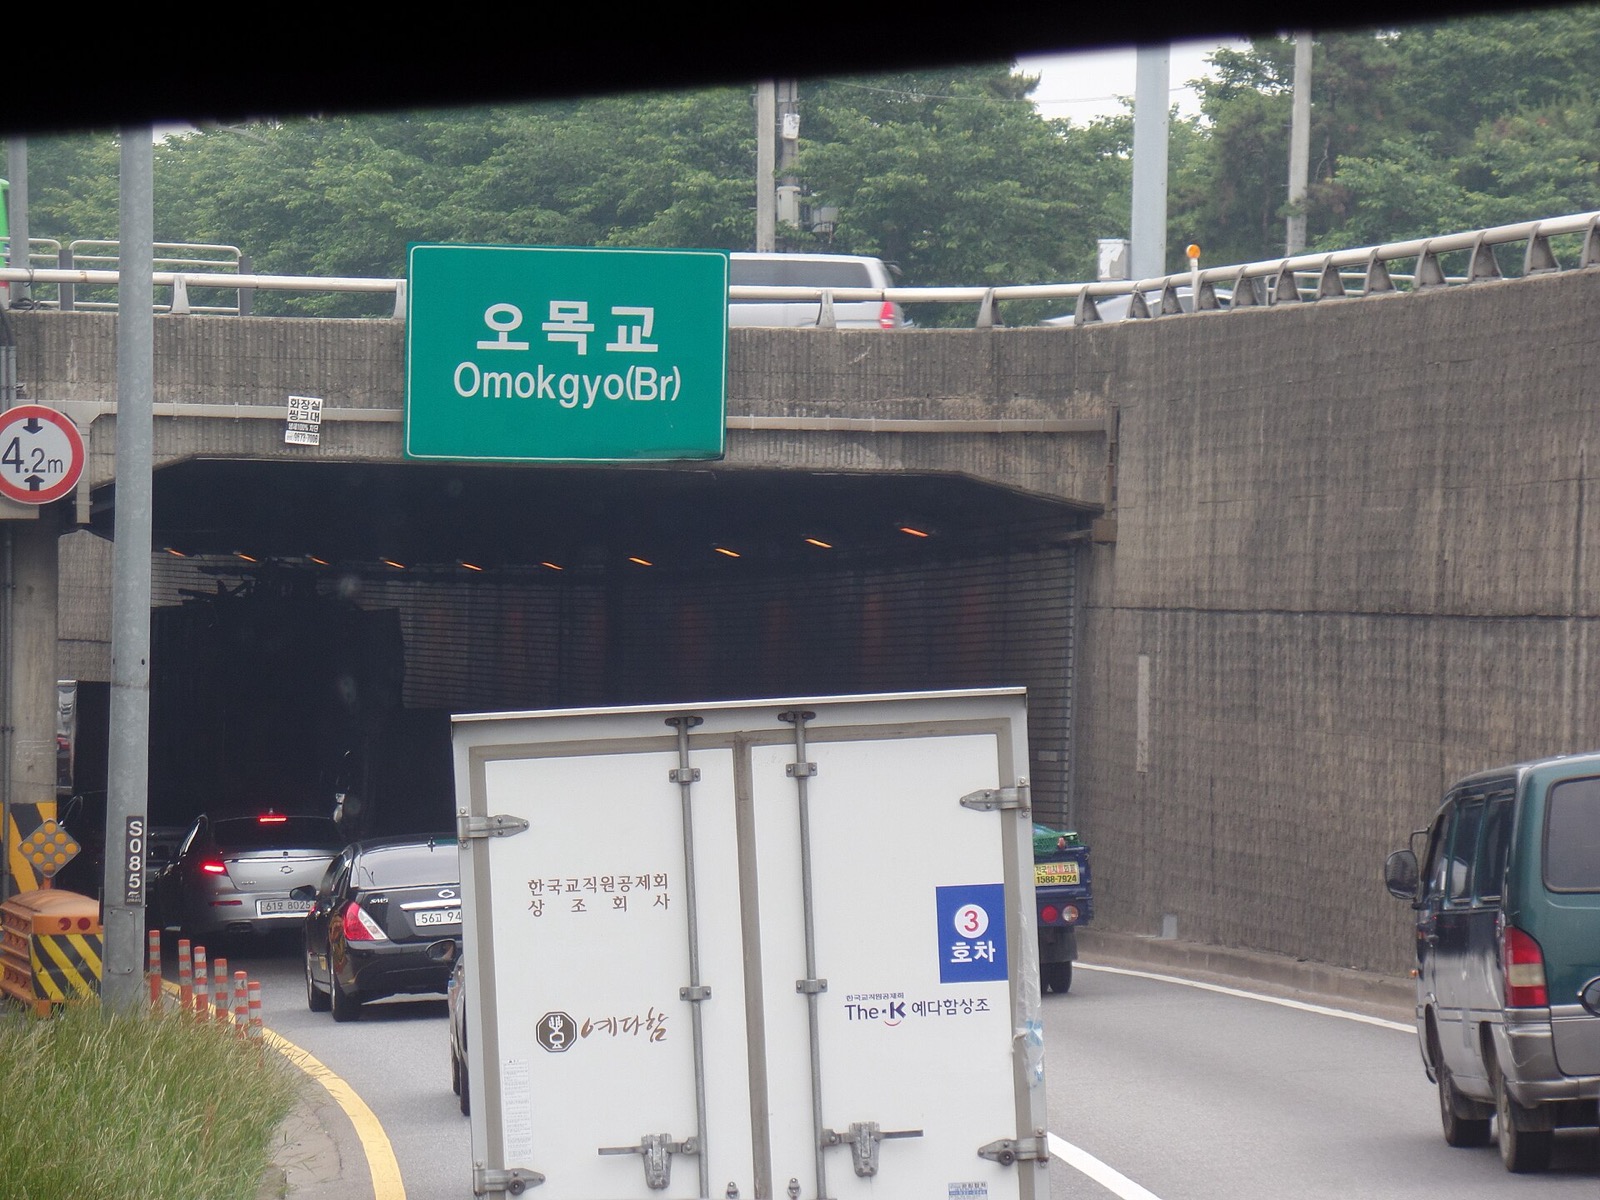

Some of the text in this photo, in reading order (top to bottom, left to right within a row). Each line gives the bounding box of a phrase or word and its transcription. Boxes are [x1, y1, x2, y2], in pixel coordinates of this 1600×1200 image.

[476, 300, 659, 355] 오목교
[453, 361, 681, 409] Omokgyo(Br)
[289, 410, 320, 422] 씽크대
[290, 398, 321, 411] 화장실
[1, 436, 63, 474] 4.2m
[128, 820, 143, 889] S085
[527, 873, 668, 896] 한국교직원공제회
[1036, 875, 1077, 884] 1588-7924
[288, 901, 311, 910] 8025
[964, 910, 979, 932] 3
[950, 940, 996, 963] 호차
[911, 998, 991, 1017] 예다함상조
[580, 1006, 669, 1043] 예다함
